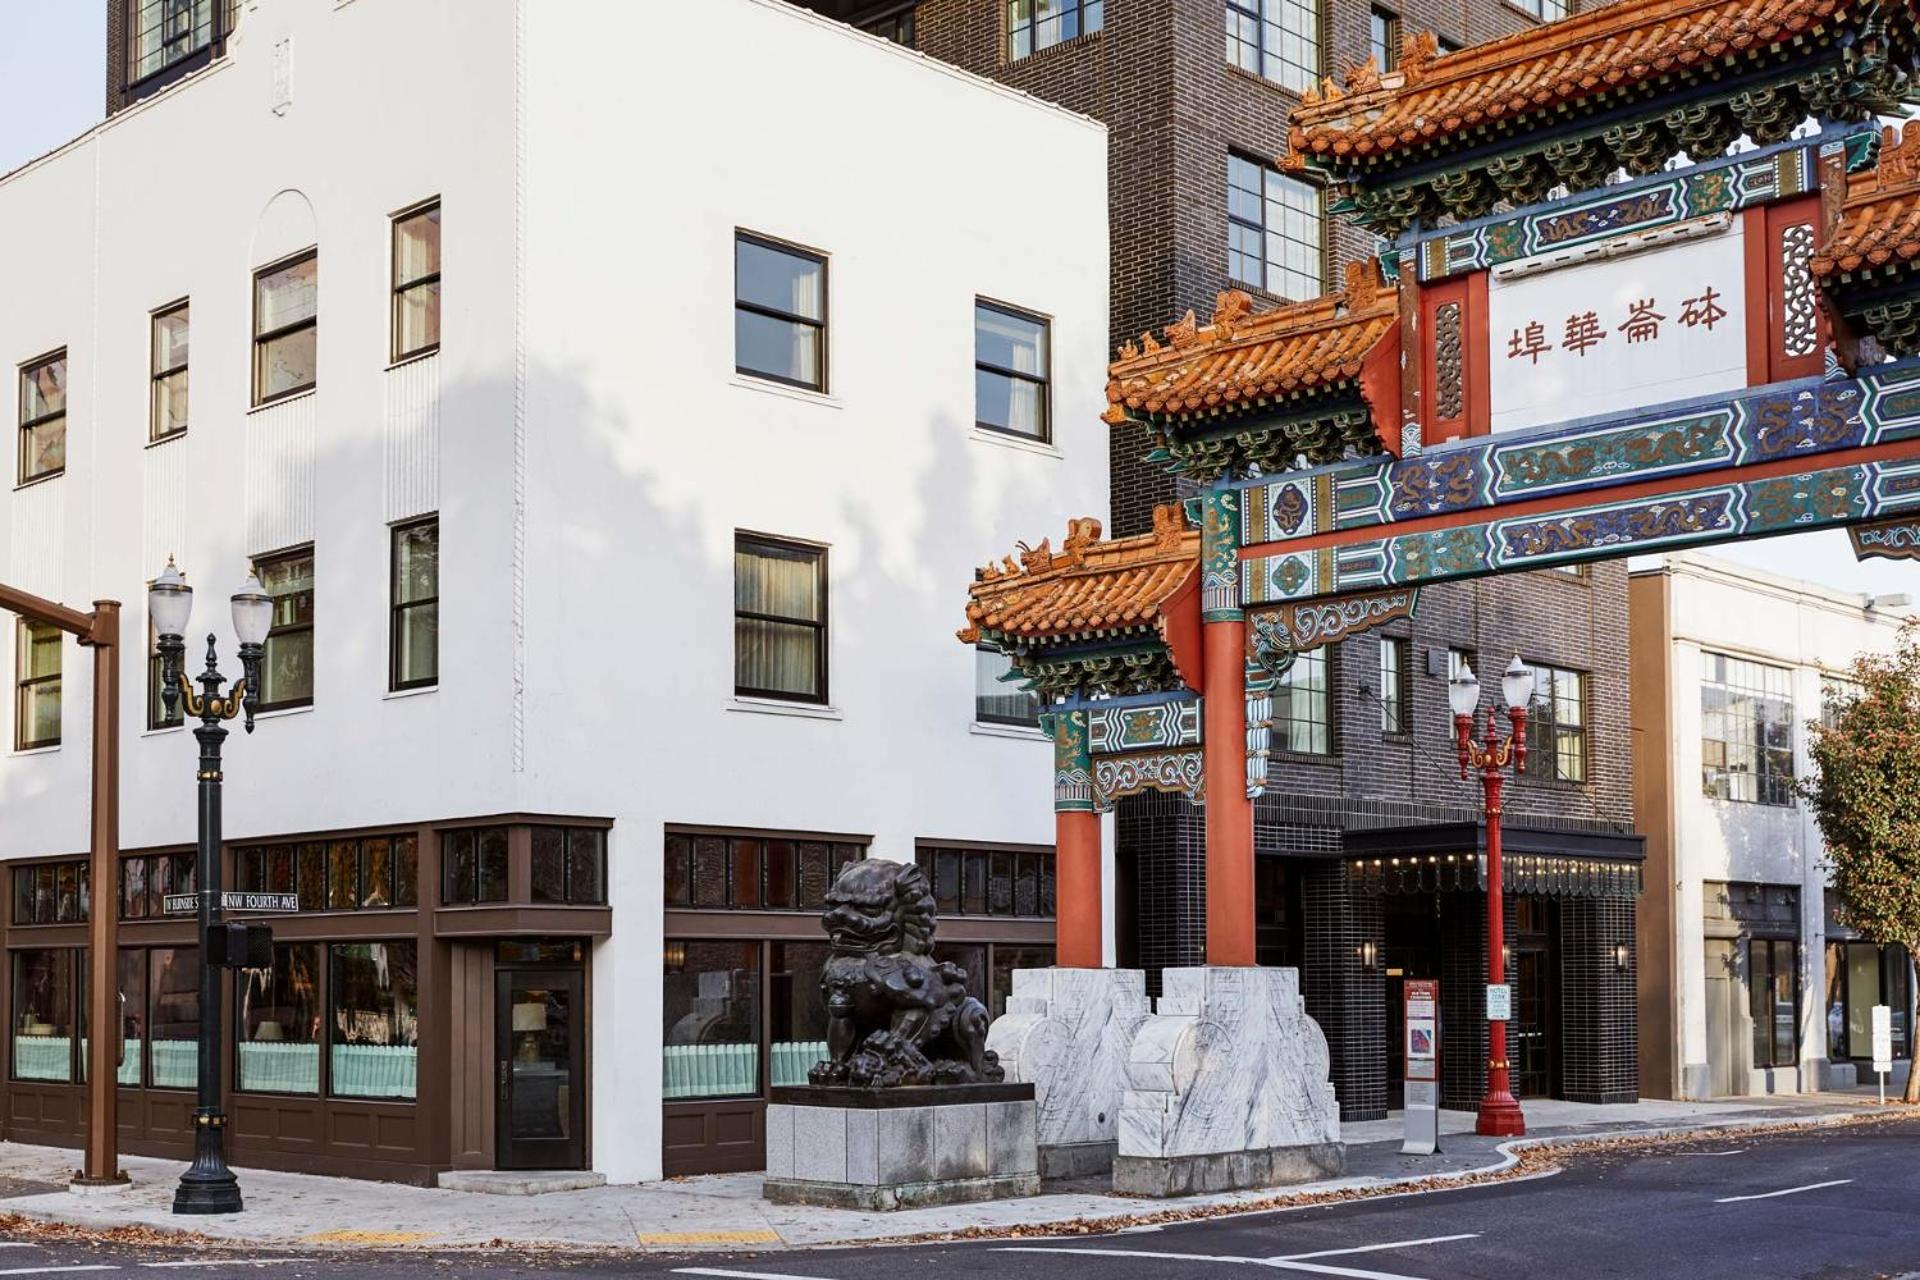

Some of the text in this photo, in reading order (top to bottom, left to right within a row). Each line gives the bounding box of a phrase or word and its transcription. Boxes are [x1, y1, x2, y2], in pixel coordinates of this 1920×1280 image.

[228, 894, 243, 908] NW
[246, 895, 279, 908] FOURTH
[281, 896, 296, 909] AVE
